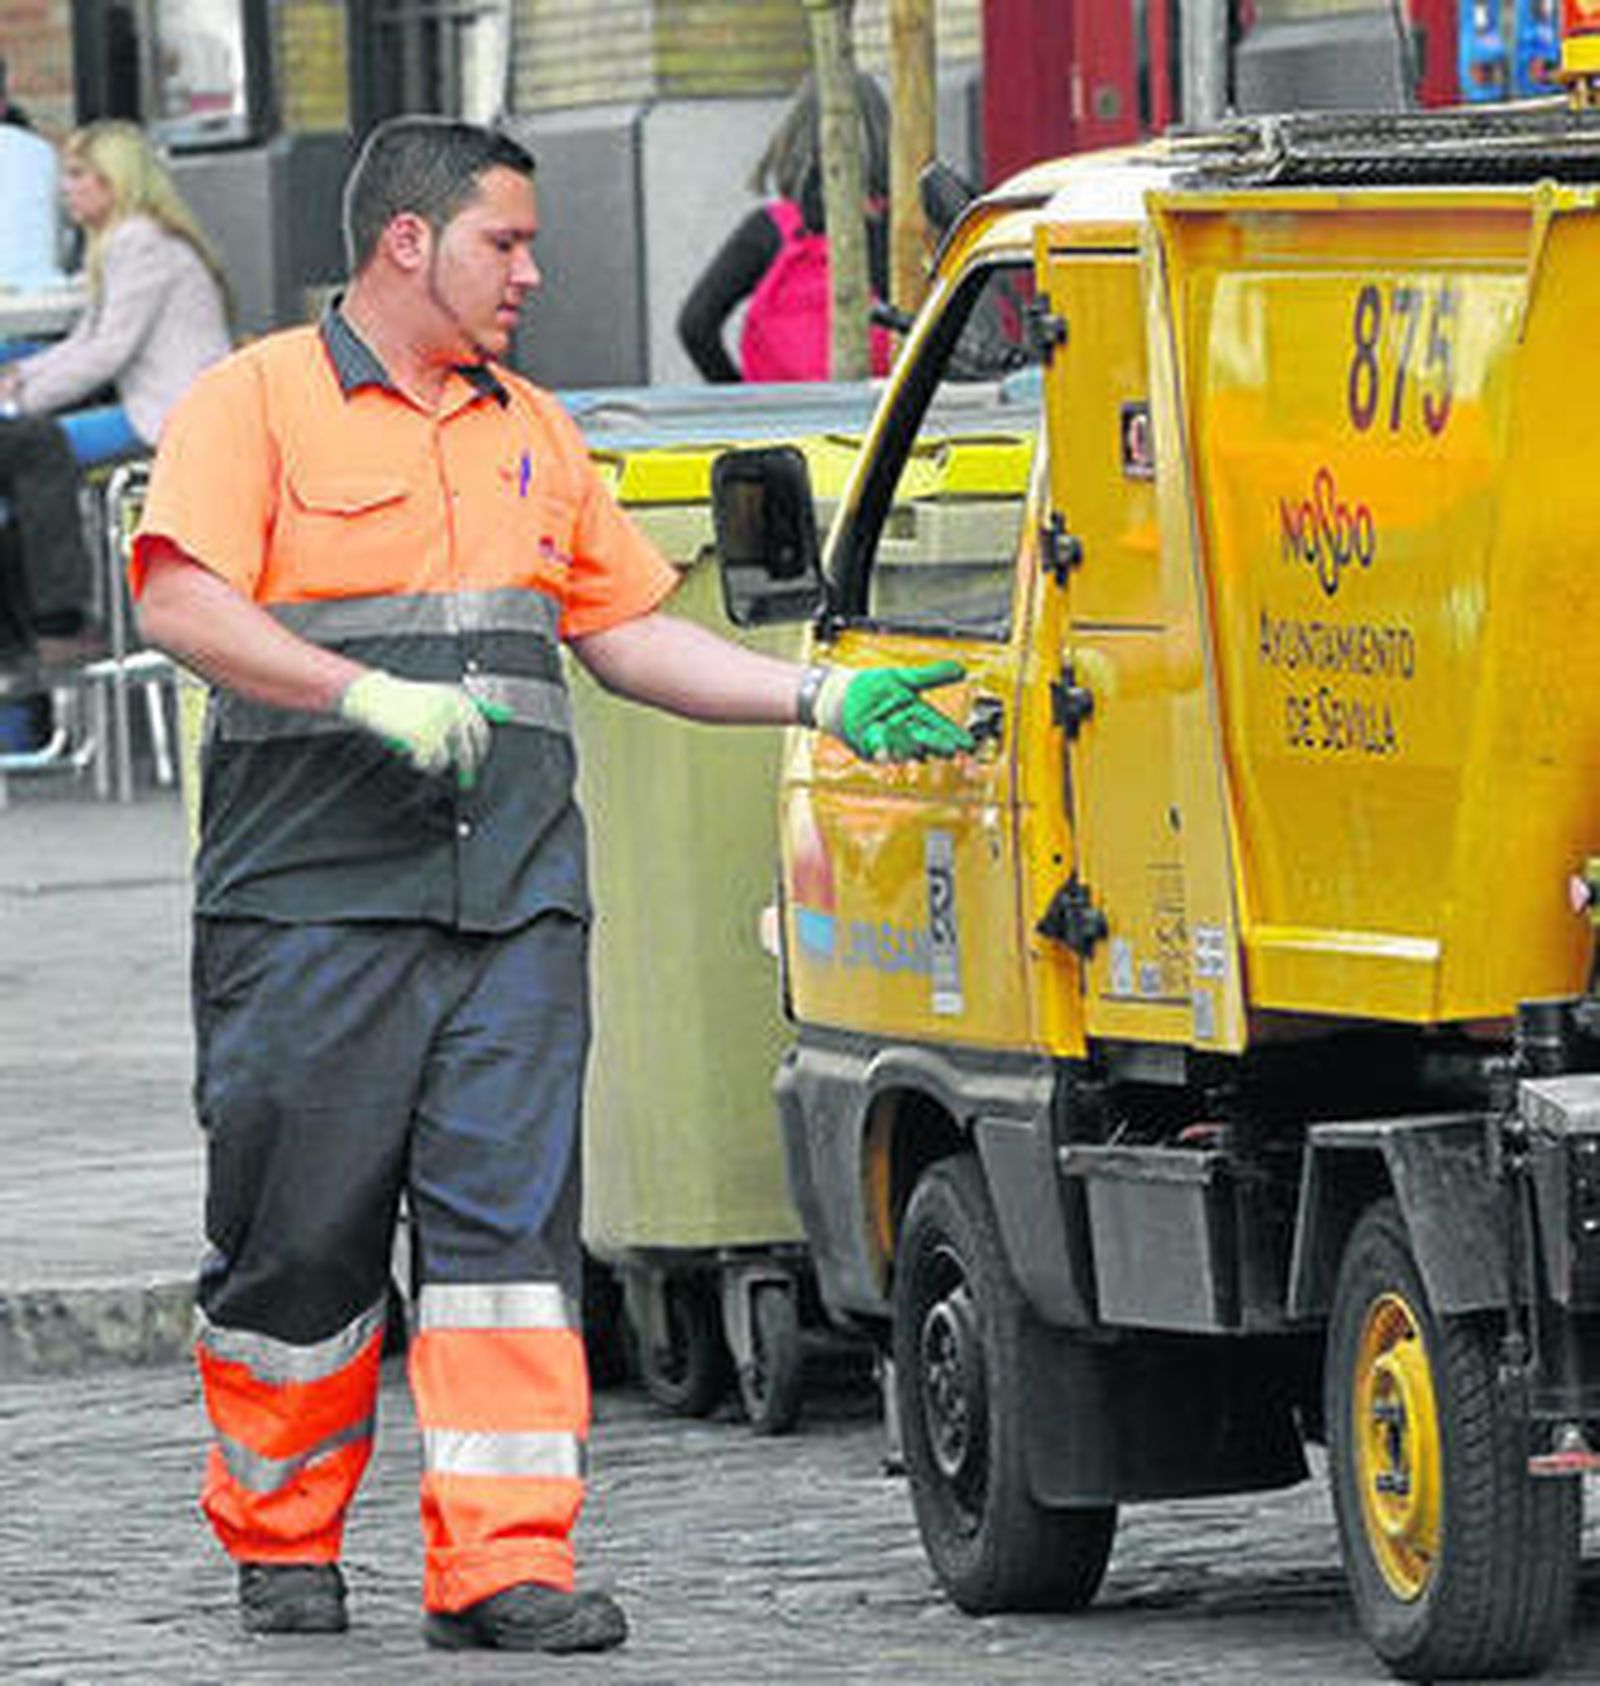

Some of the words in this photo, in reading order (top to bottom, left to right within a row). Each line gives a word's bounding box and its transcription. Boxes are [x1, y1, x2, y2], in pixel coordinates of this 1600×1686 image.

[1348, 284, 1455, 437] 875
[1259, 611, 1415, 681] AYUNTAMIENTO
[1286, 695, 1315, 748] DE
[1317, 686, 1400, 755] SEVILLA
